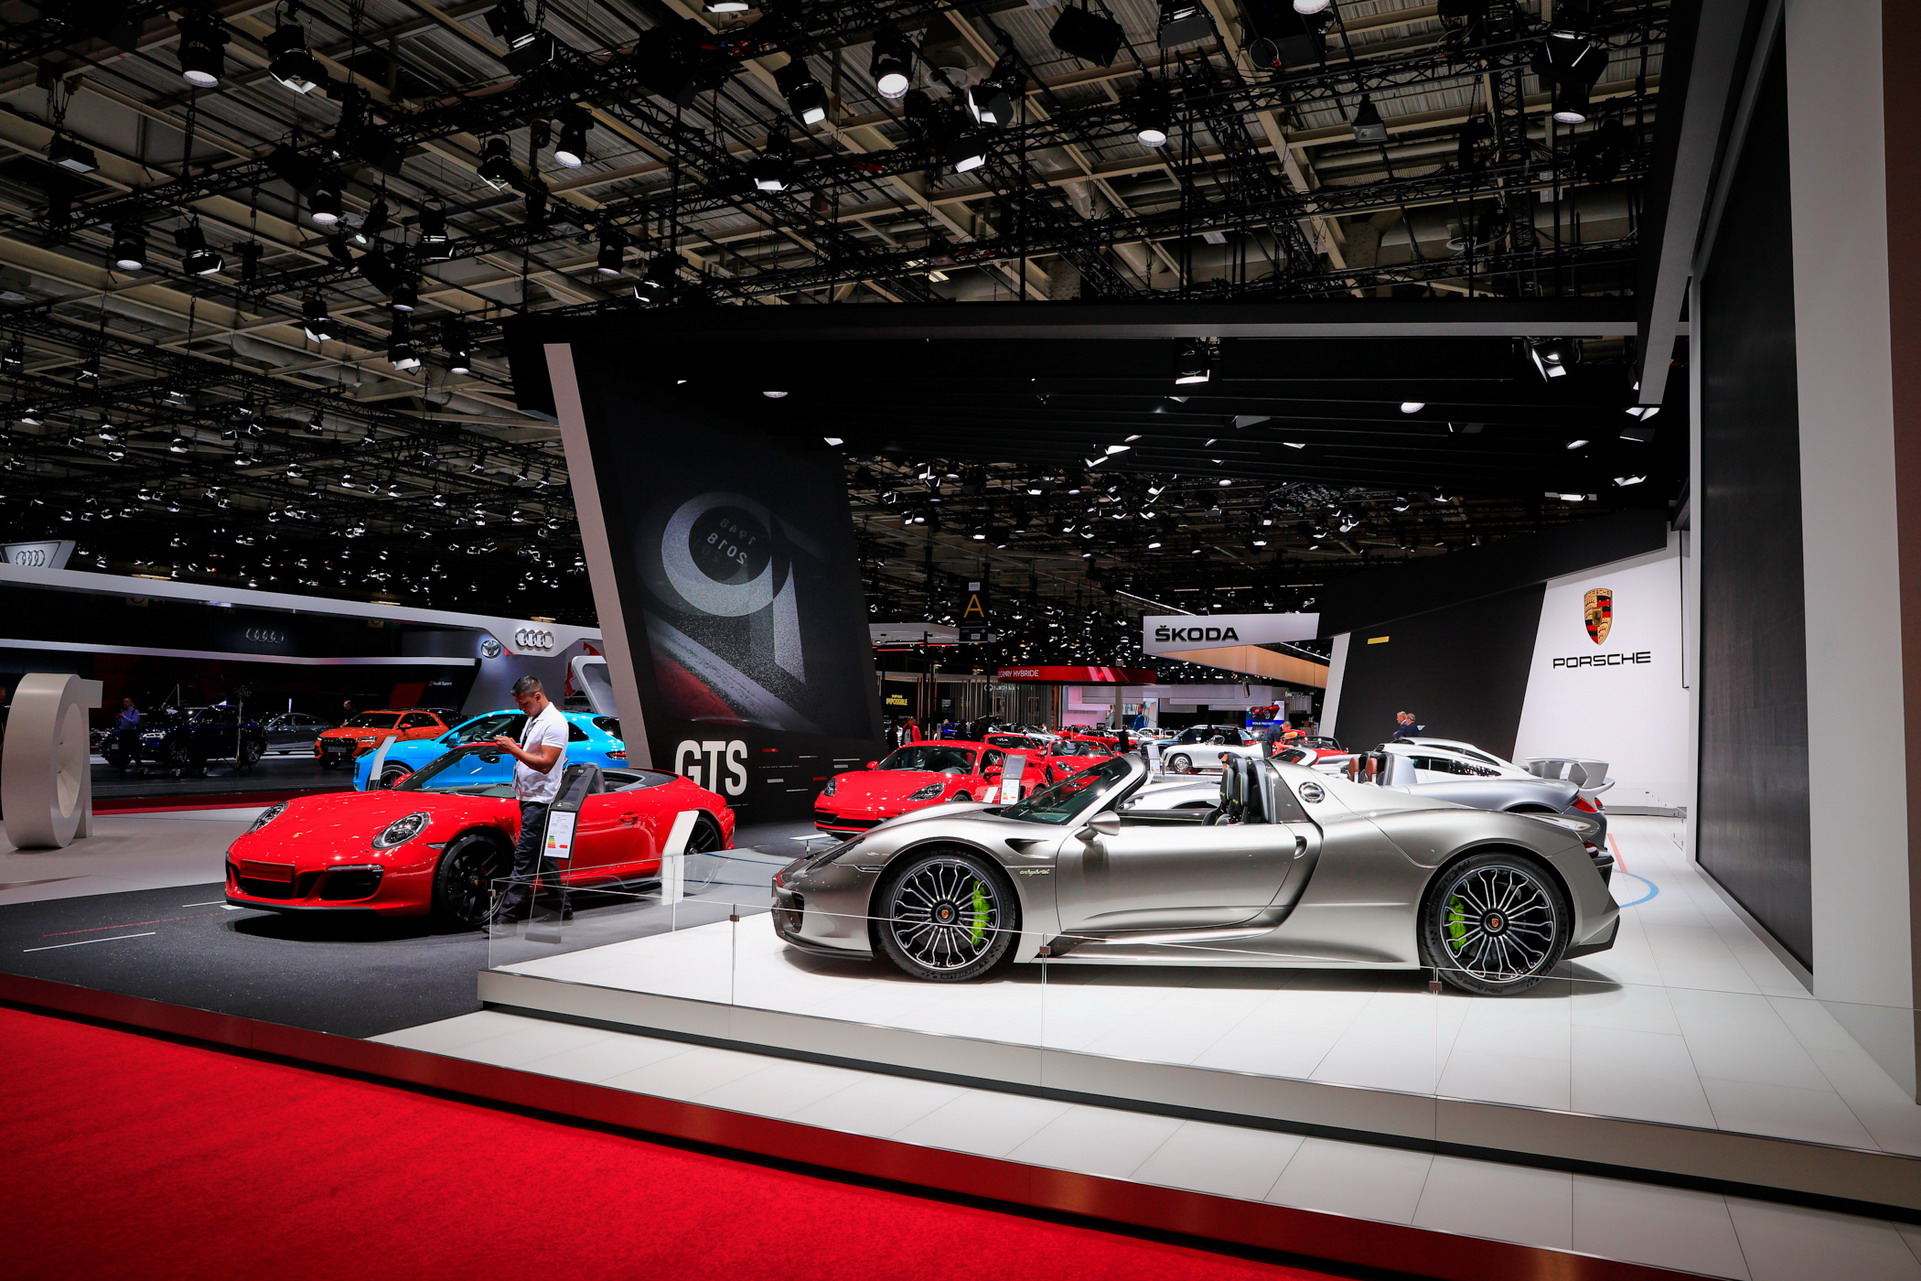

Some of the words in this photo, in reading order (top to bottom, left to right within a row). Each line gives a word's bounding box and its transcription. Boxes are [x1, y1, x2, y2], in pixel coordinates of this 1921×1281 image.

[962, 593, 985, 618] A
[1155, 625, 1239, 642] ŠKODA
[1552, 651, 1651, 669] PORSCHE
[1013, 669, 1039, 678] HYBRIDE
[674, 739, 748, 797] GTS
